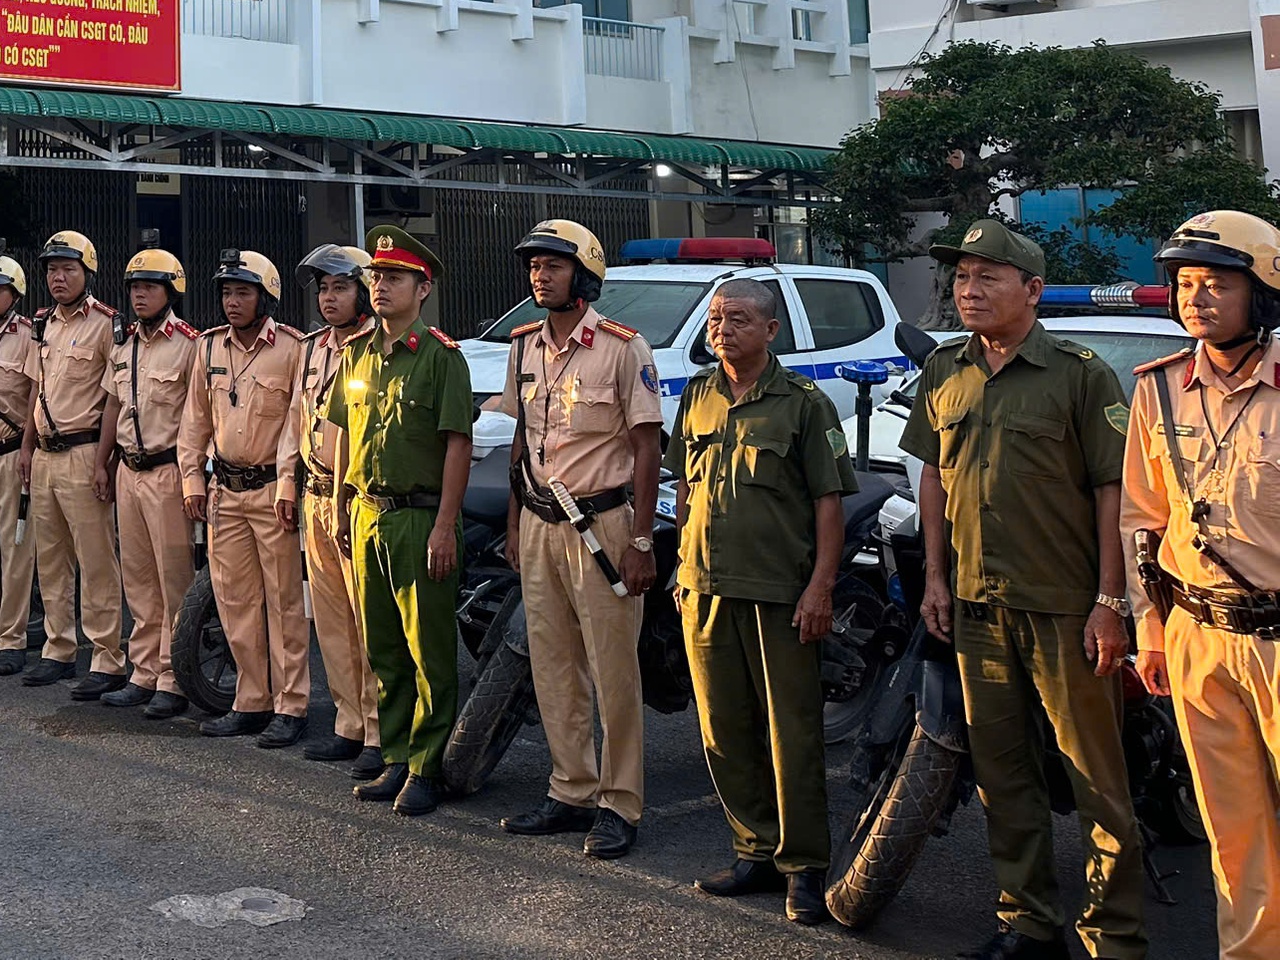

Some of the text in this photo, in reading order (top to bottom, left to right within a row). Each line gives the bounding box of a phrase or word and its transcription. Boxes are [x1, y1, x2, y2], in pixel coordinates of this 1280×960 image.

[32, 13, 54, 37] DÂN
[56, 13, 78, 39] CẦN
[81, 20, 107, 41] CSGT
[109, 21, 126, 45] CÓ,
[128, 23, 148, 45] ĐÂU
[4, 43, 19, 66] CÓ
